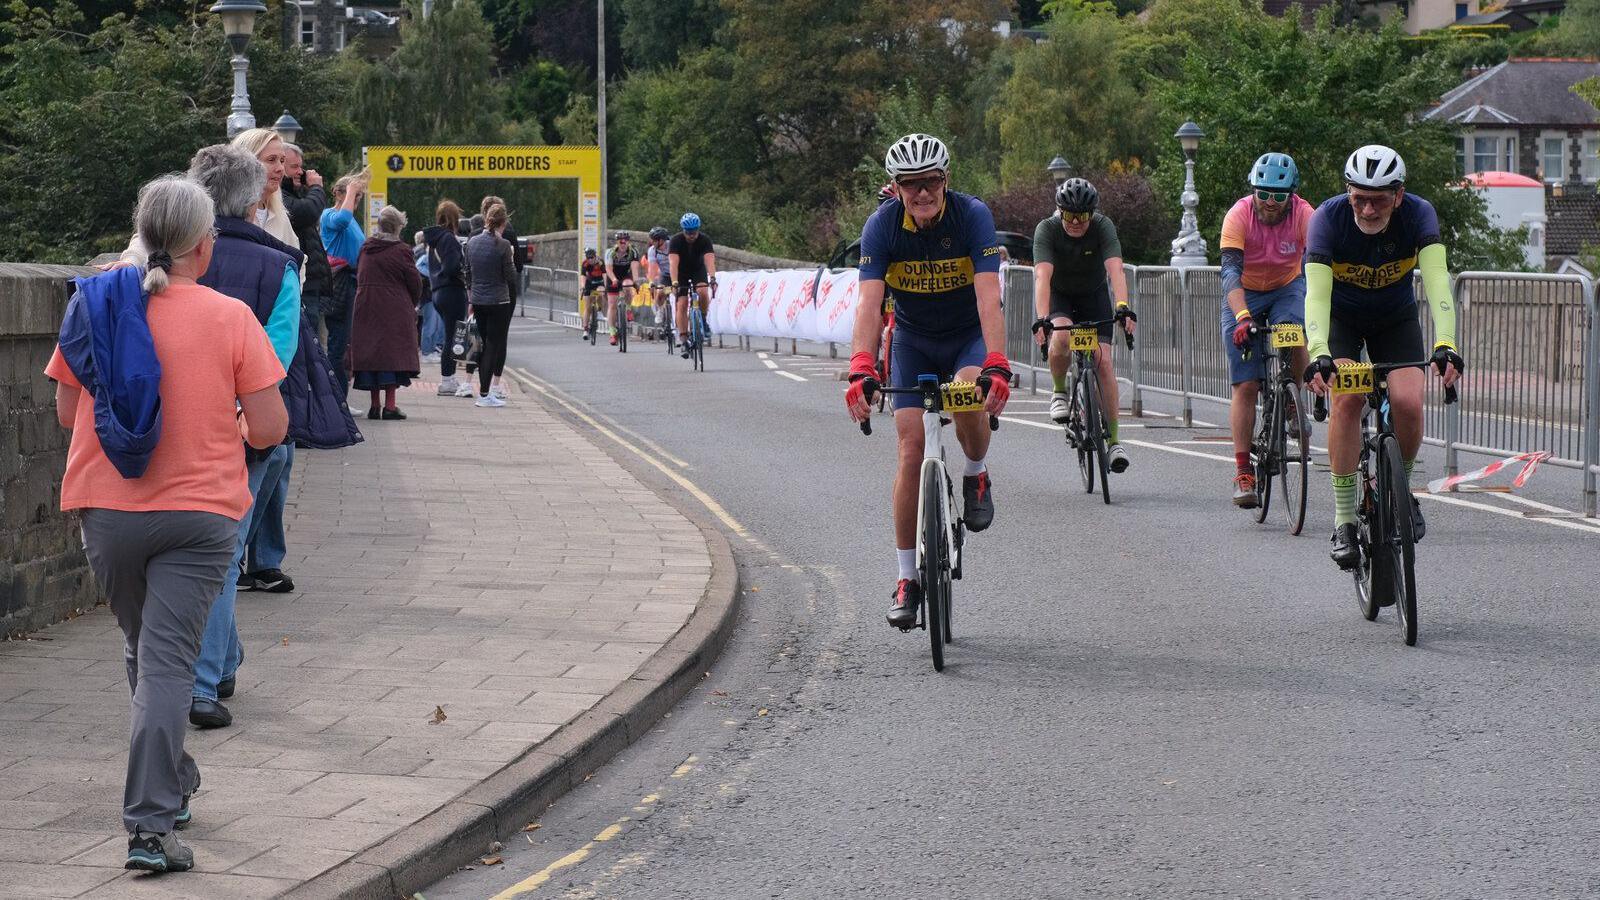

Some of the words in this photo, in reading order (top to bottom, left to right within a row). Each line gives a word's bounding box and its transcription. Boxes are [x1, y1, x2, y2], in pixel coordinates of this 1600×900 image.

[409, 156, 443, 170] TOUR
[448, 157, 456, 170] O
[460, 157, 484, 170] THE
[489, 157, 550, 170] BORDERS
[904, 261, 958, 276] DUNDEE
[1346, 264, 1401, 278] DUNDEE
[898, 273, 968, 290] WHEELERS
[1074, 336, 1092, 346] 847
[1278, 332, 1298, 343] 568
[1336, 374, 1371, 388] 1514
